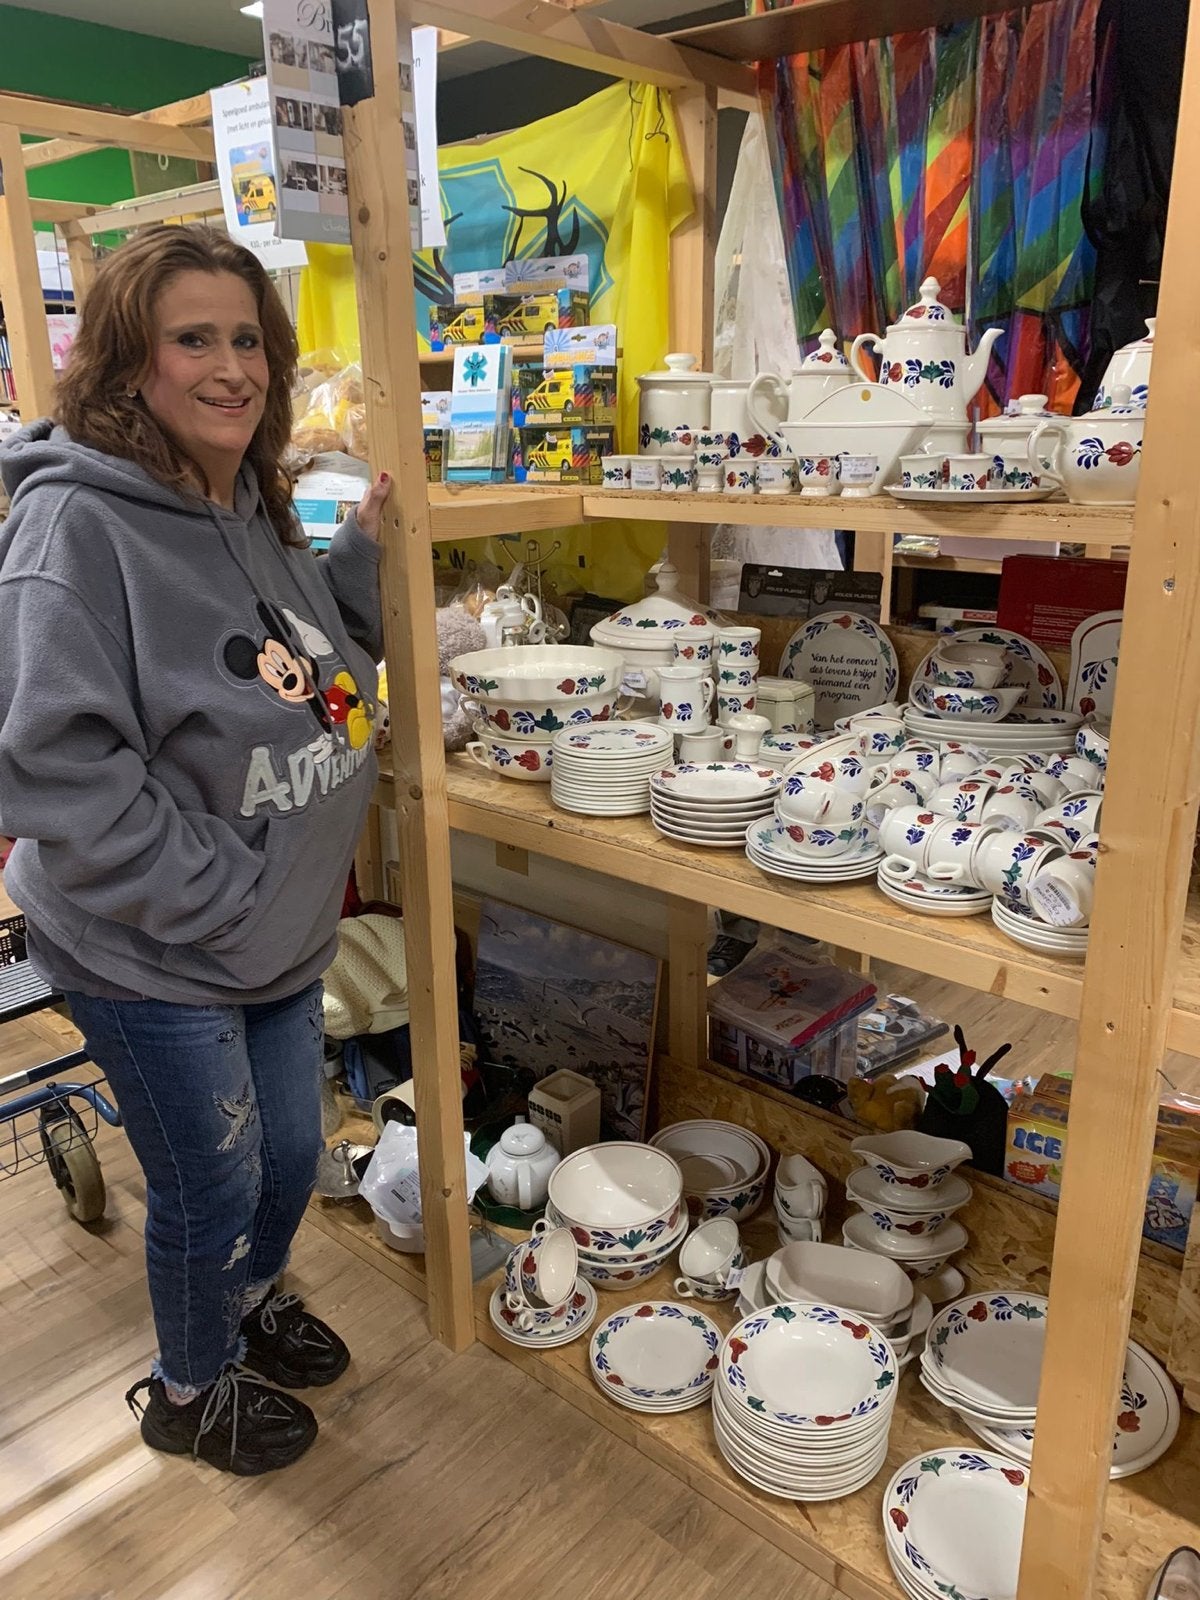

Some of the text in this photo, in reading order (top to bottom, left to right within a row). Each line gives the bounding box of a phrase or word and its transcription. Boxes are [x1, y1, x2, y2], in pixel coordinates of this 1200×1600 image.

[811, 653, 878, 666] Van het concert
[853, 668, 877, 682] krijgt
[812, 677, 870, 690] niemand een
[818, 690, 861, 703] program
[1013, 1127, 1062, 1160] ICE
